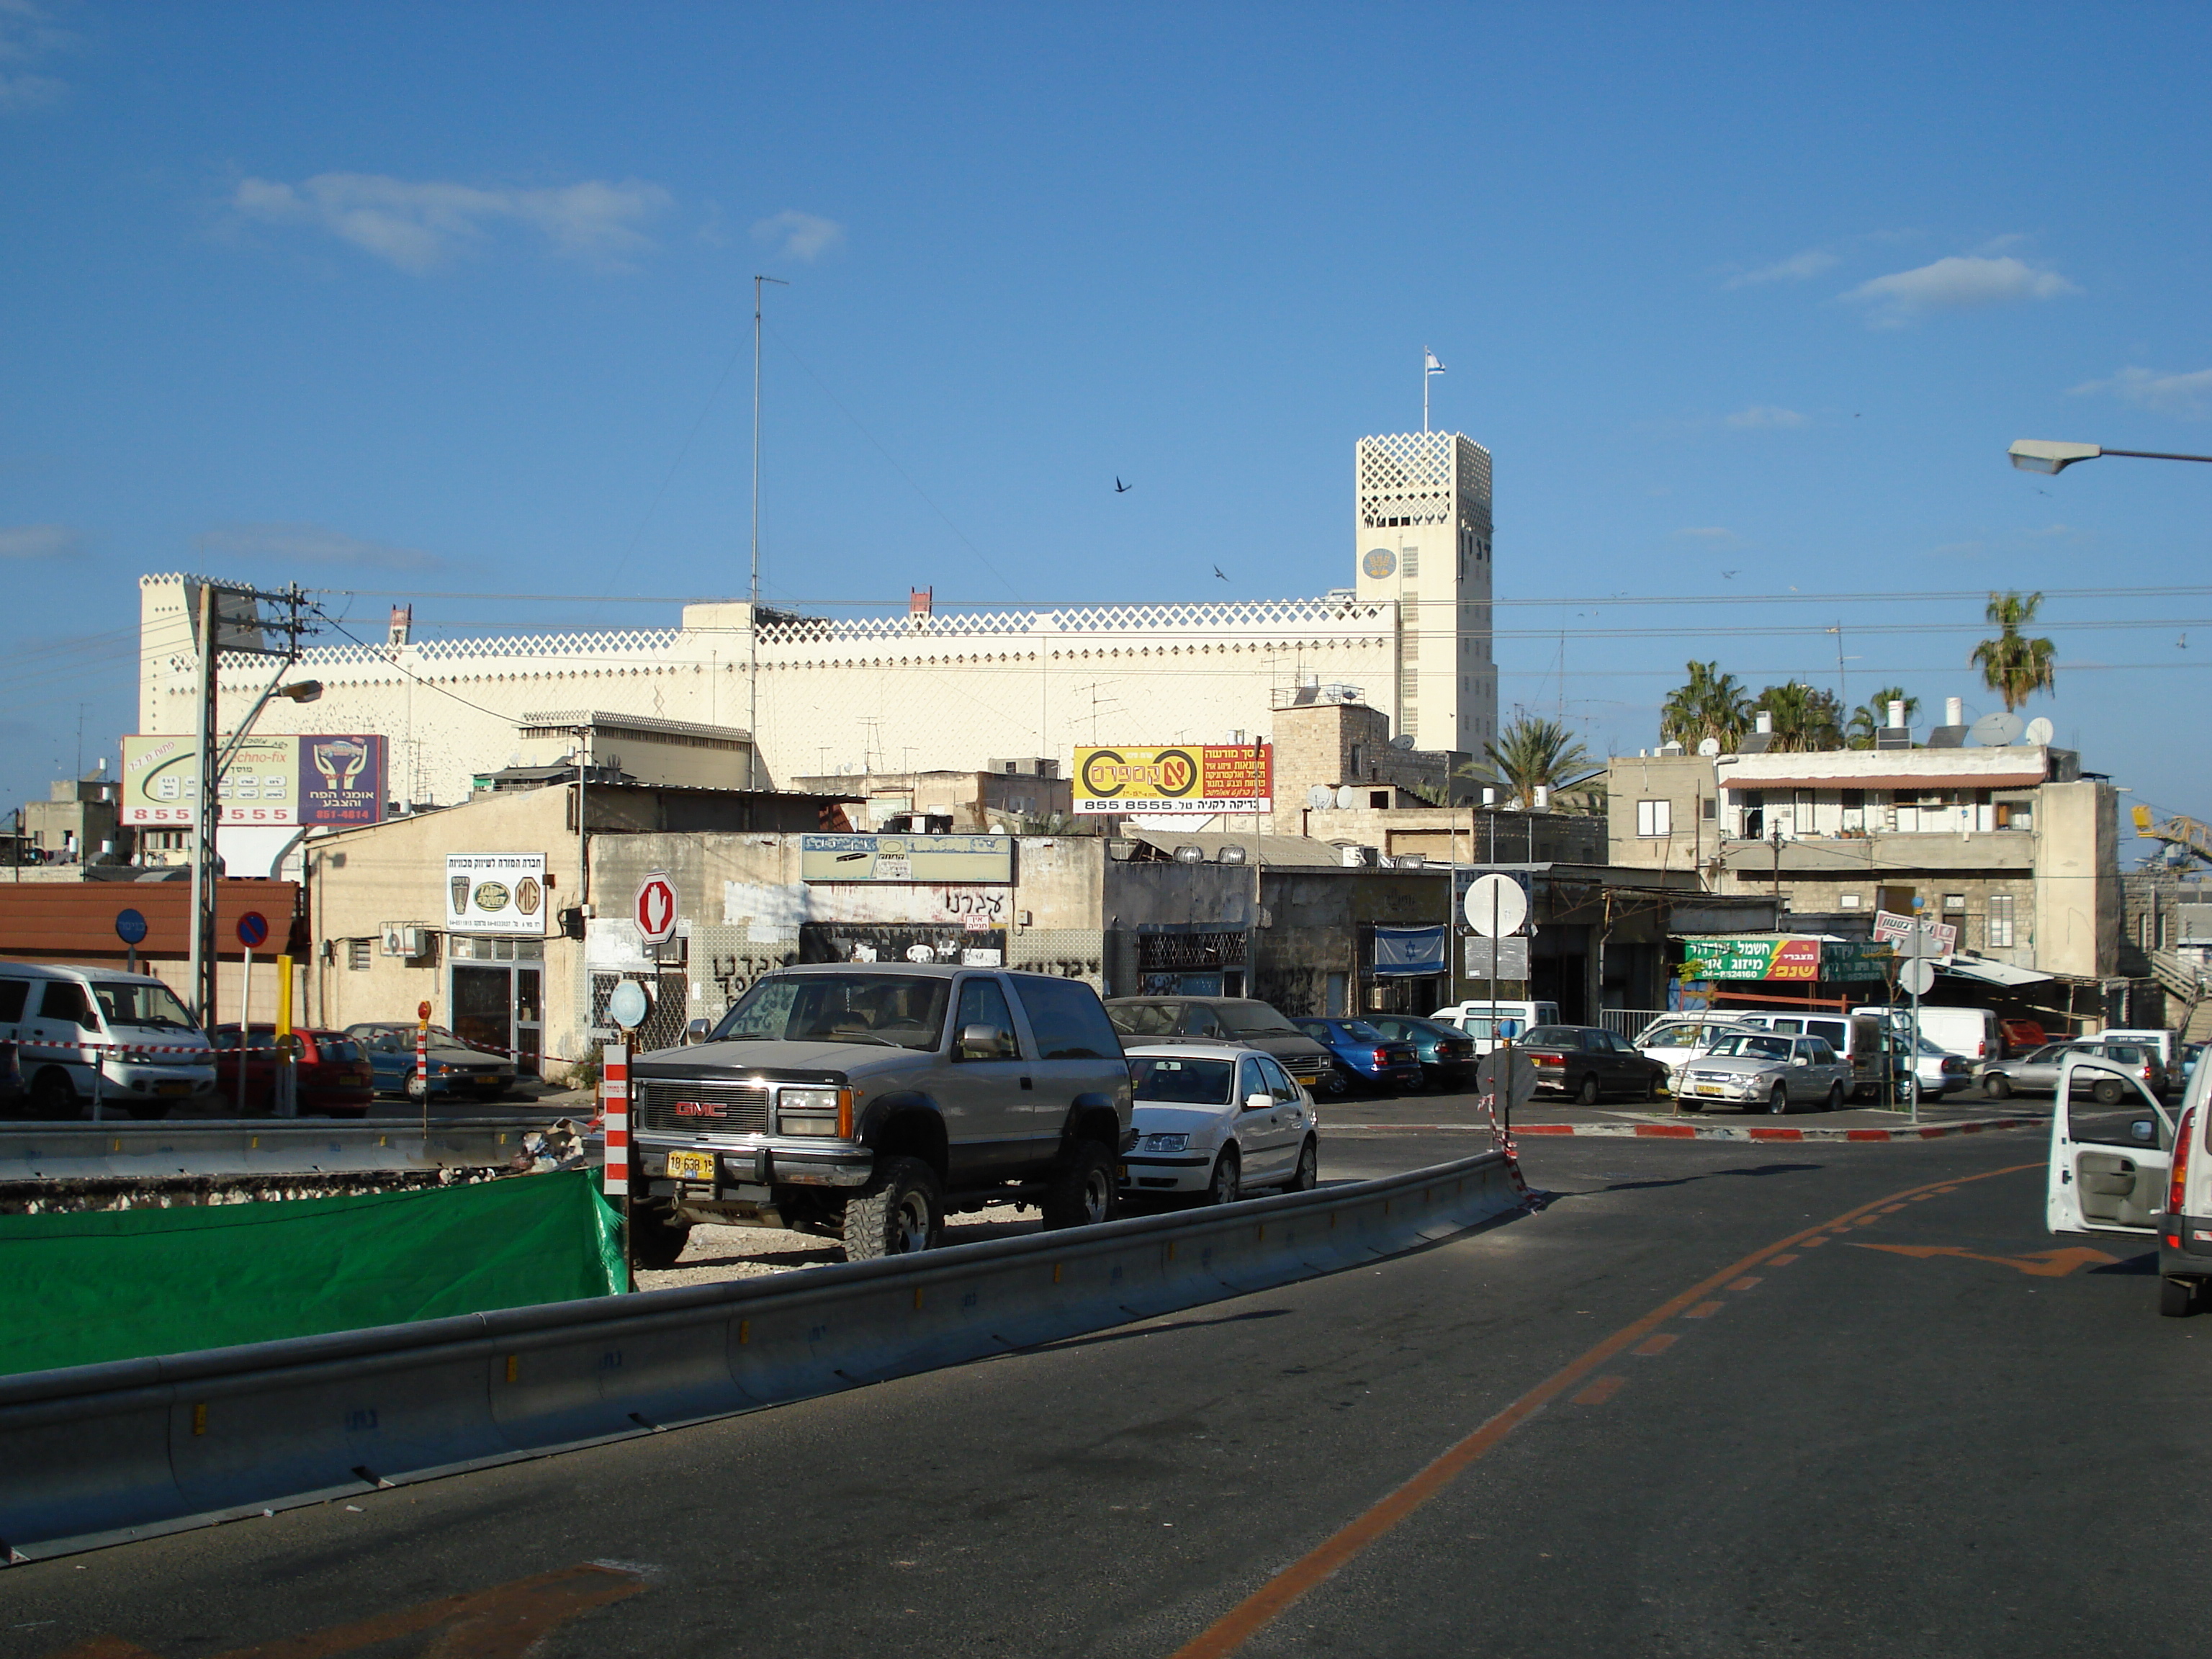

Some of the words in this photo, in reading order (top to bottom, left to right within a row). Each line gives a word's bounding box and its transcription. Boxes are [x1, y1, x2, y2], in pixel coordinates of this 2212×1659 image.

[1205, 750, 1238, 759] מורשה
[1241, 749, 1265, 760] מסך
[1234, 761, 1265, 770] מונאות
[1092, 761, 1184, 786] אקספרס
[1084, 801, 1120, 809] 855
[1125, 801, 1172, 809] 8555
[1197, 799, 1226, 809] לקניה
[473, 858, 495, 870] לשיווק
[498, 858, 521, 868] המזרח
[521, 858, 541, 868] חברת
[519, 881, 537, 910] MG
[1737, 940, 1770, 956] חשמל
[1732, 958, 1763, 970] מיזוג
[1775, 966, 1816, 978] שנפ
[675, 1102, 727, 1117] GMC
